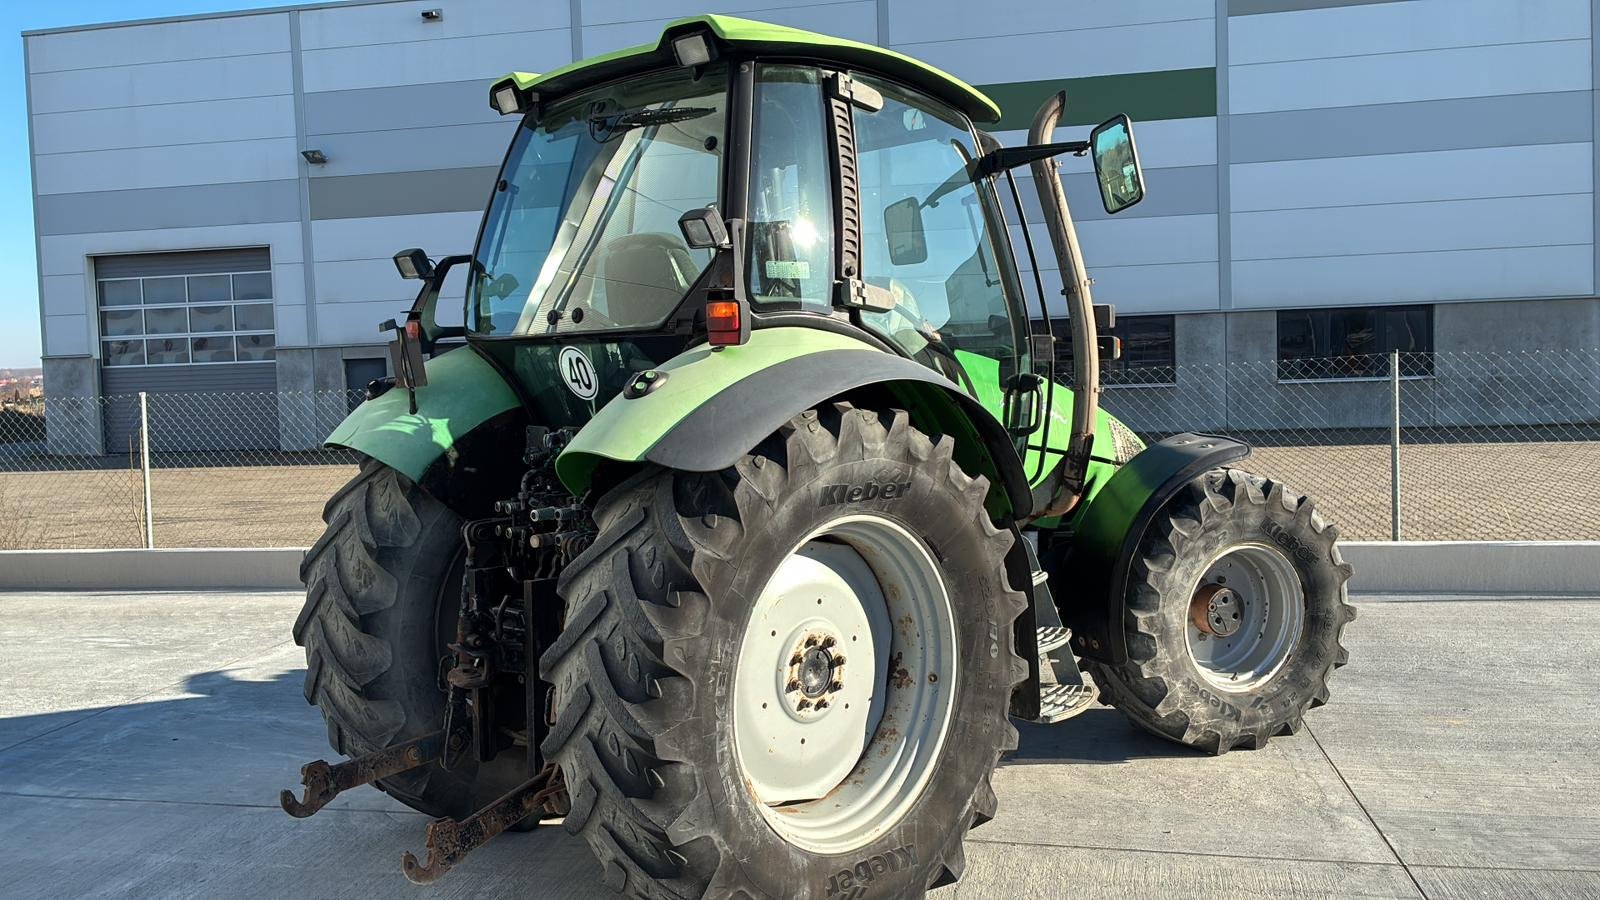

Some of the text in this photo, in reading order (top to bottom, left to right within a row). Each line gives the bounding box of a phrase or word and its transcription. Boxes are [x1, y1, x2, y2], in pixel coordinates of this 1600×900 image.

[568, 356, 592, 390] 40
[819, 481, 912, 507] Kleber
[1258, 515, 1321, 564] Kleber
[1187, 677, 1242, 721] Kleber
[825, 843, 918, 897] Kleber
